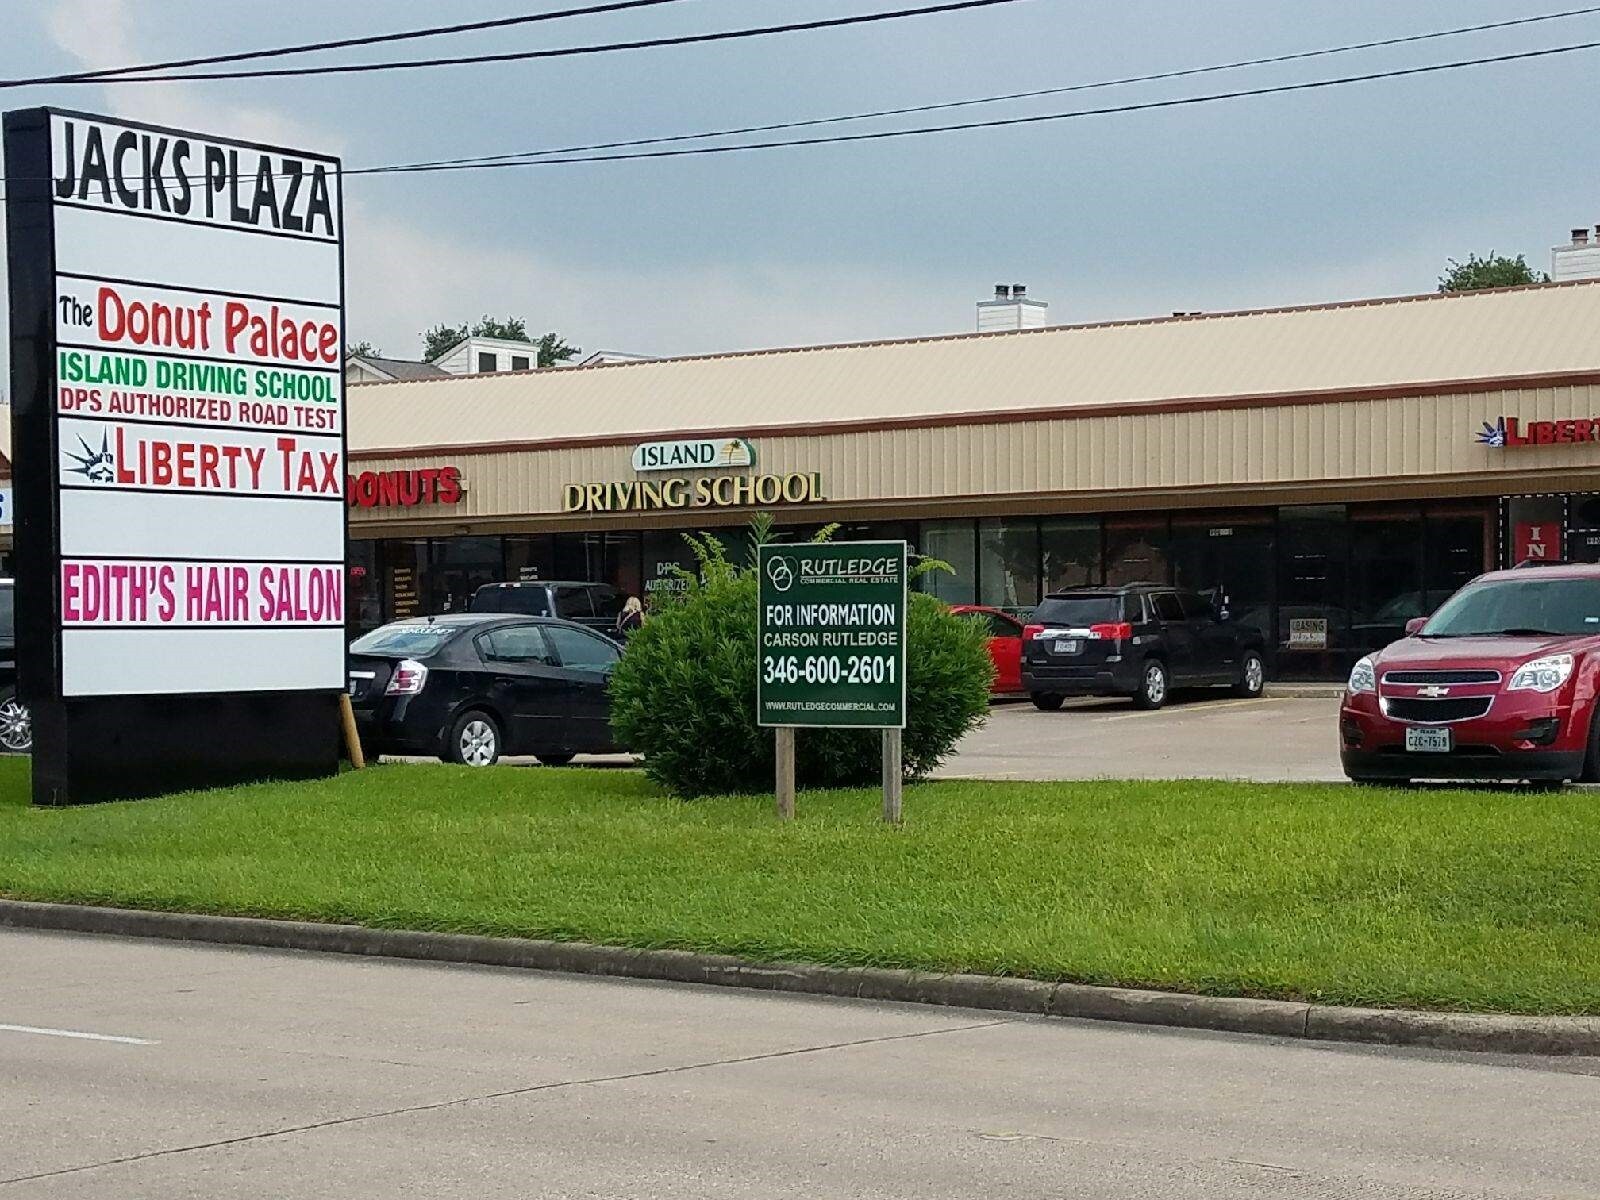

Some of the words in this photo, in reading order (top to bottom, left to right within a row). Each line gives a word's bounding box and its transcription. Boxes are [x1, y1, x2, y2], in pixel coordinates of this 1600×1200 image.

[56, 122, 191, 215] JACKS
[205, 145, 334, 236] PLAZA
[59, 295, 93, 327] The
[98, 287, 211, 350] Donut
[225, 302, 338, 363] Palace
[60, 351, 147, 388] ISLAND
[156, 362, 248, 396] DRIVING
[255, 370, 337, 403] SCHOOL
[60, 387, 102, 412] DPS
[109, 389, 232, 422] AUTHORIZED
[239, 402, 288, 426] ROAD
[293, 405, 337, 430] TEST
[116, 427, 266, 490] LIBERTY
[277, 437, 340, 494] TAX
[641, 443, 715, 467] ISLAND
[564, 478, 690, 512] DRIVING
[695, 473, 824, 507] SCHOOL
[801, 558, 898, 575] RUTLEDGE
[63, 564, 176, 622] EDITH'S
[186, 566, 249, 621] HAIR
[259, 567, 342, 622] SALON
[766, 605, 793, 626] FOR
[796, 604, 895, 626] INFORMATION
[764, 632, 818, 647] CARSON
[823, 632, 898, 646] RUTLEDGE
[763, 655, 895, 684] 346-600-2601
